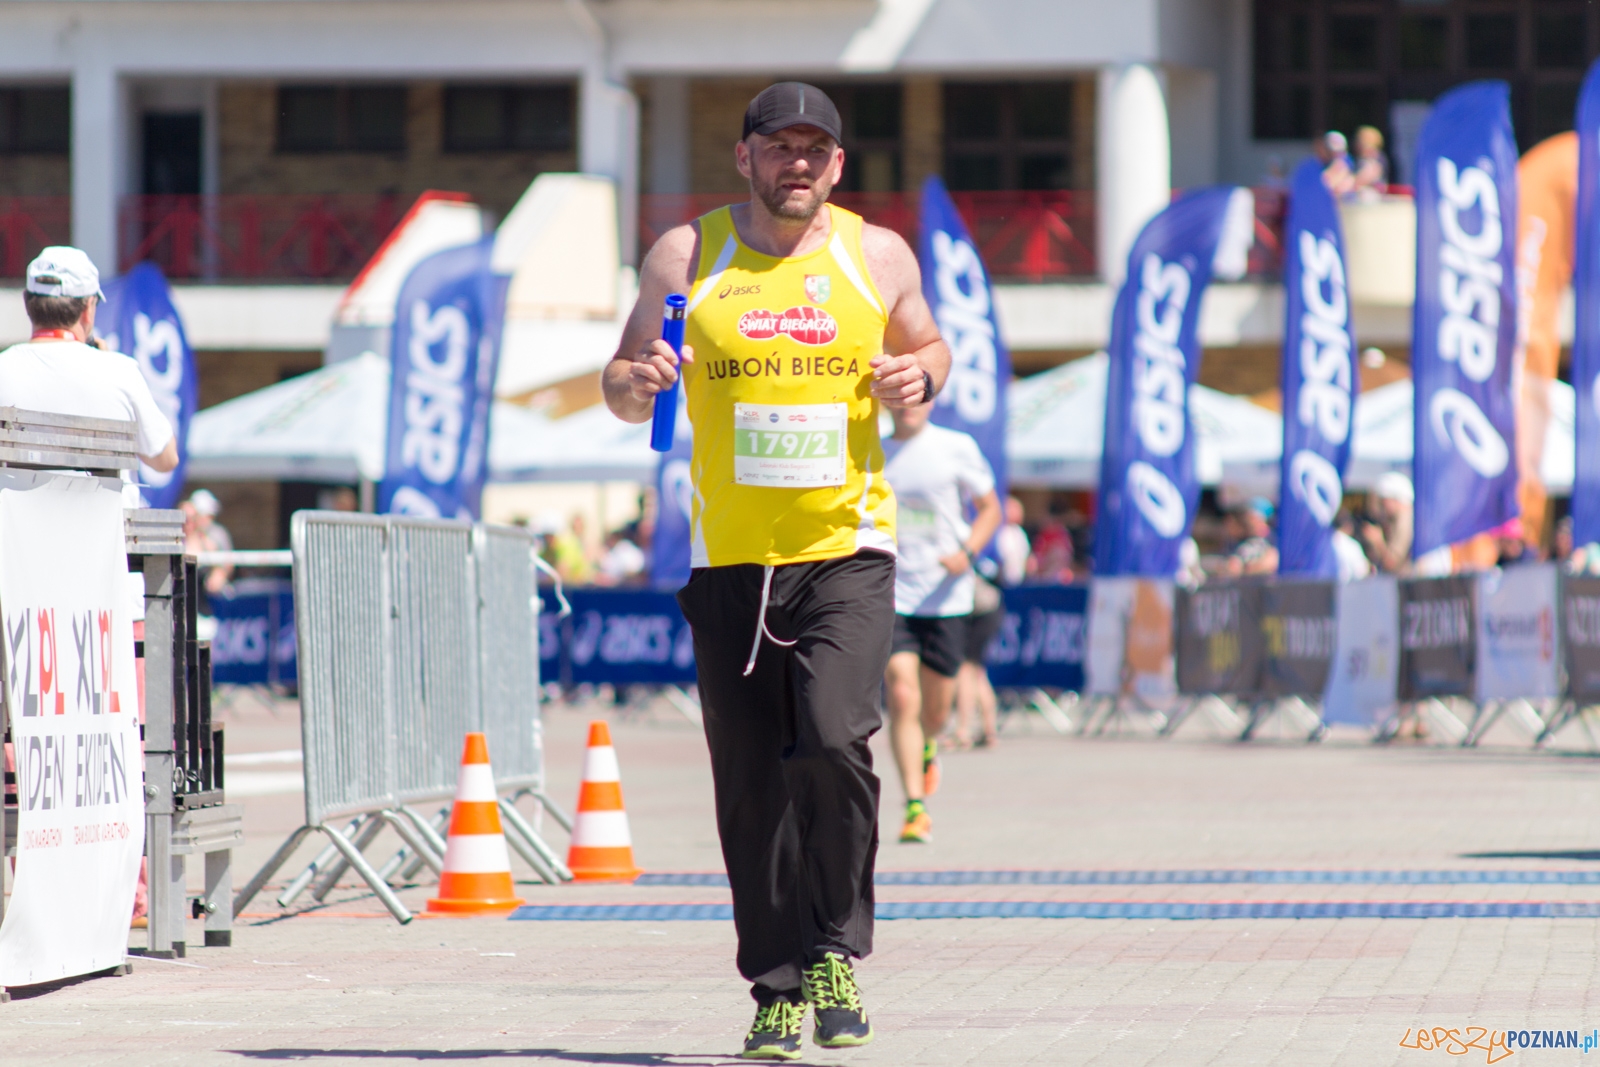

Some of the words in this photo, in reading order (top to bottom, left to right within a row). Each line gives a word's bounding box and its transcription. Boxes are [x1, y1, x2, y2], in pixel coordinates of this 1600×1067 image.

[733, 284, 761, 296] asics
[1437, 156, 1502, 382] asics
[740, 315, 778, 332] ŚWIAT
[779, 317, 835, 332] BIEGACZA
[1132, 252, 1191, 457] asics
[1298, 229, 1351, 445] asics
[403, 298, 470, 484] asics
[707, 351, 781, 380] LUBOŃ
[792, 356, 860, 377] BIEGA
[747, 431, 828, 458] 179/2
[75, 731, 128, 808] EKIDEN
